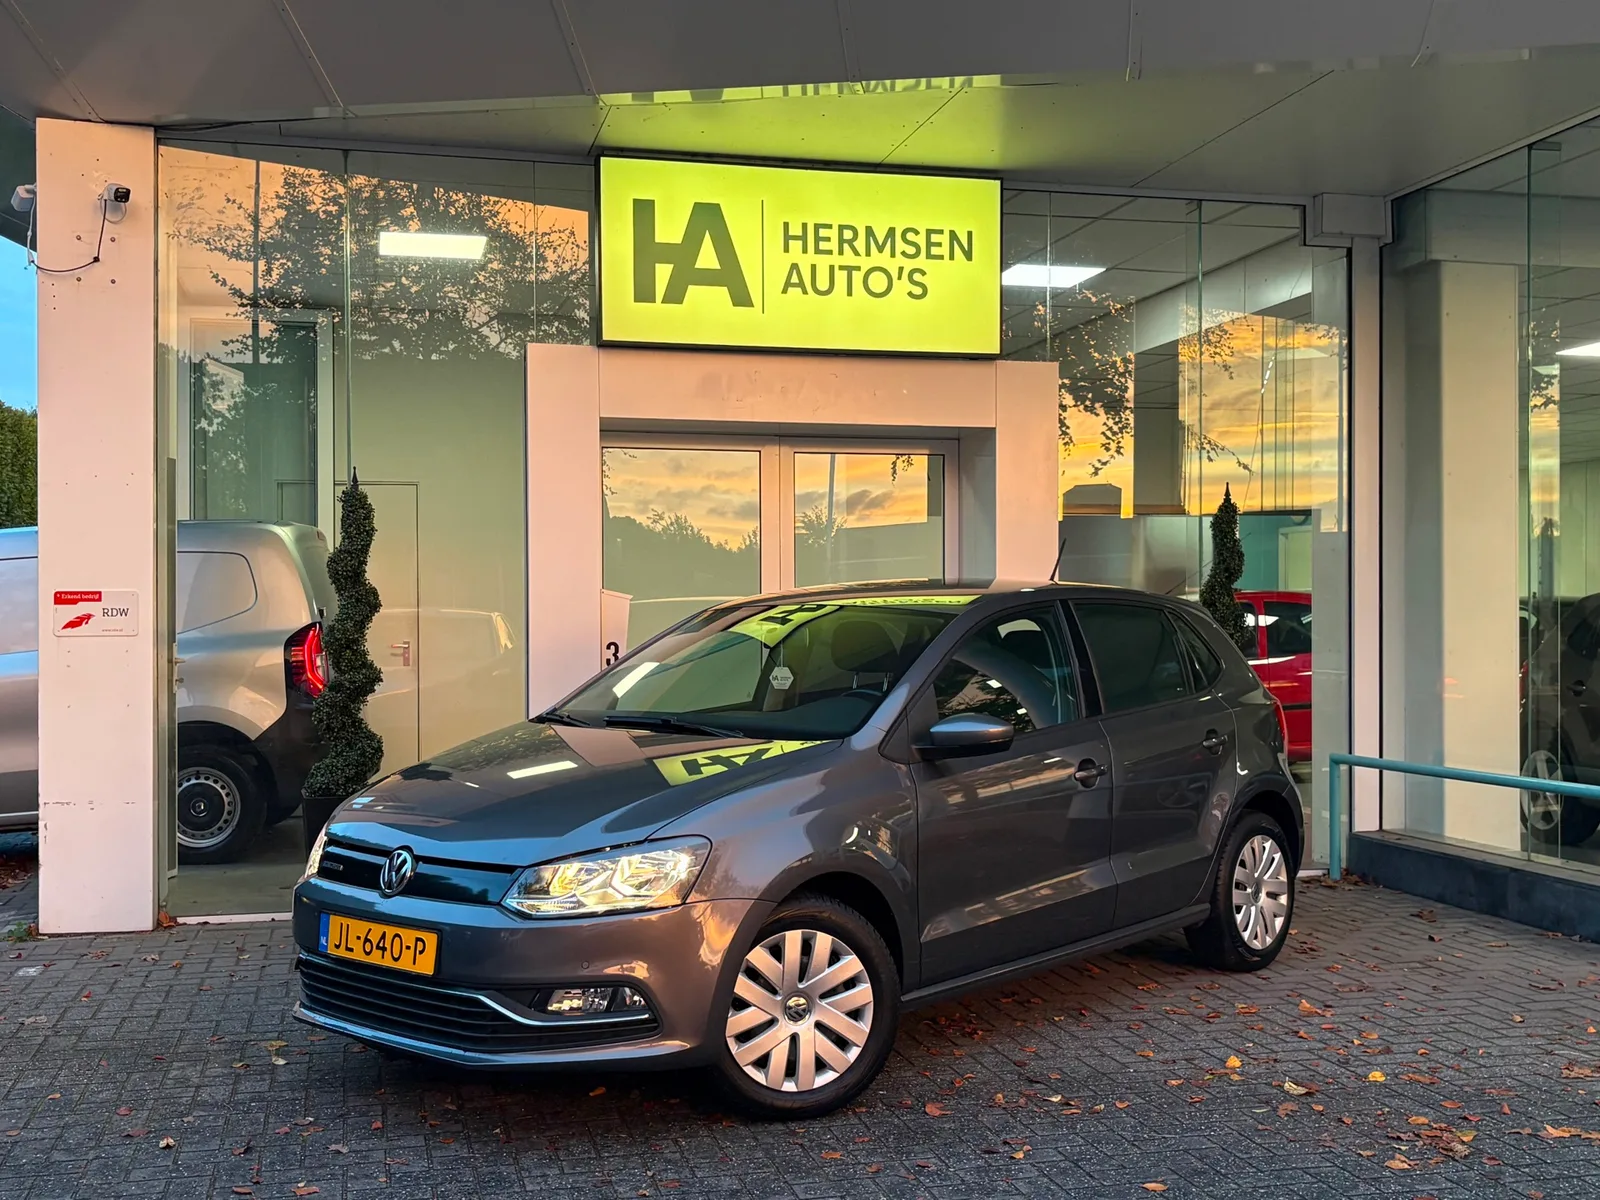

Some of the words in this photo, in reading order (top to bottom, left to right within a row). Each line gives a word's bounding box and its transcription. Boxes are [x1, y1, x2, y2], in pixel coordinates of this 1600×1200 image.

[632, 198, 755, 308] HA
[782, 221, 974, 262] HERMSEN
[781, 262, 929, 300] AUTO'S
[102, 607, 130, 617] RDW
[605, 641, 620, 667] 3
[333, 922, 427, 966] JL-640-P
